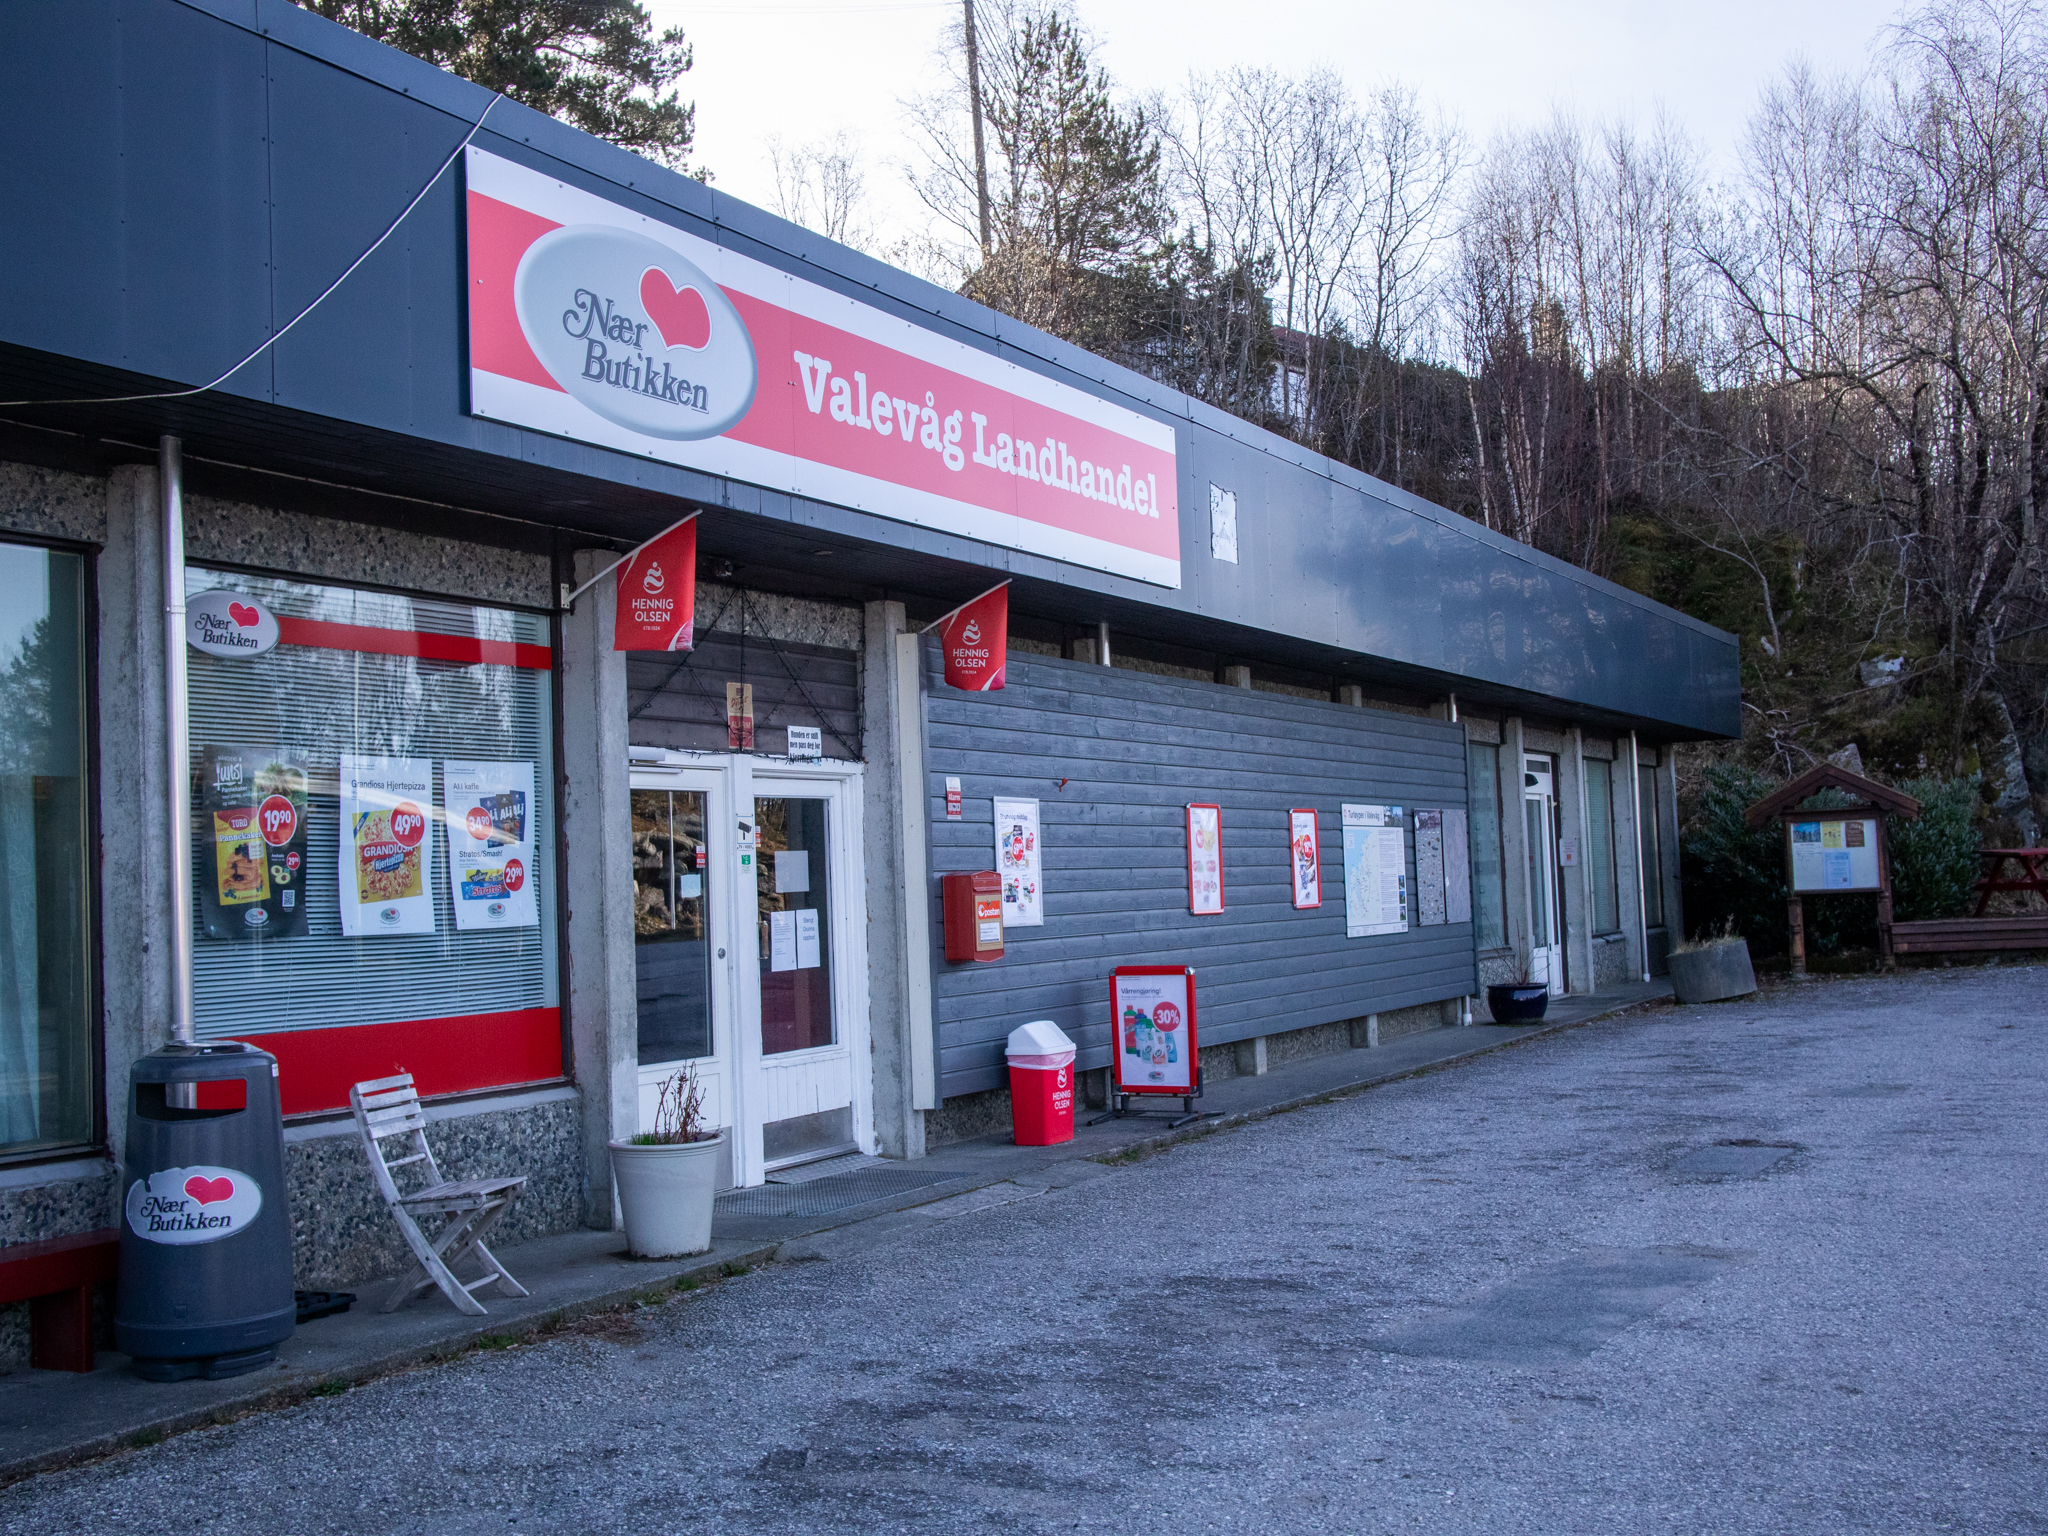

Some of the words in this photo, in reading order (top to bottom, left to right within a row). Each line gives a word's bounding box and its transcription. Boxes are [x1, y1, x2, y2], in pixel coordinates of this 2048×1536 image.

[562, 288, 649, 350] Nær
[581, 337, 710, 414] Butikken
[793, 350, 966, 472] Valevåg
[972, 411, 1160, 519] Landhandel
[632, 598, 674, 609] HENNIG
[194, 612, 232, 631] Nær
[634, 611, 671, 622] OLSEN
[202, 628, 258, 649] Butikken
[952, 648, 989, 658] HENNIG
[955, 658, 986, 668] OLSEN
[386, 781, 426, 792] Hjertepizza
[948, 793, 961, 801] Alarm
[231, 818, 248, 828] TORO
[219, 831, 262, 842] Pannekaker
[472, 884, 502, 897] Stratos
[984, 908, 1000, 918] posten
[1153, 1009, 1179, 1024] -30%
[1052, 1090, 1071, 1101] HENNIG
[1054, 1099, 1070, 1110] OLSEN
[140, 1196, 189, 1217] Nær
[148, 1212, 232, 1232] Butikken
